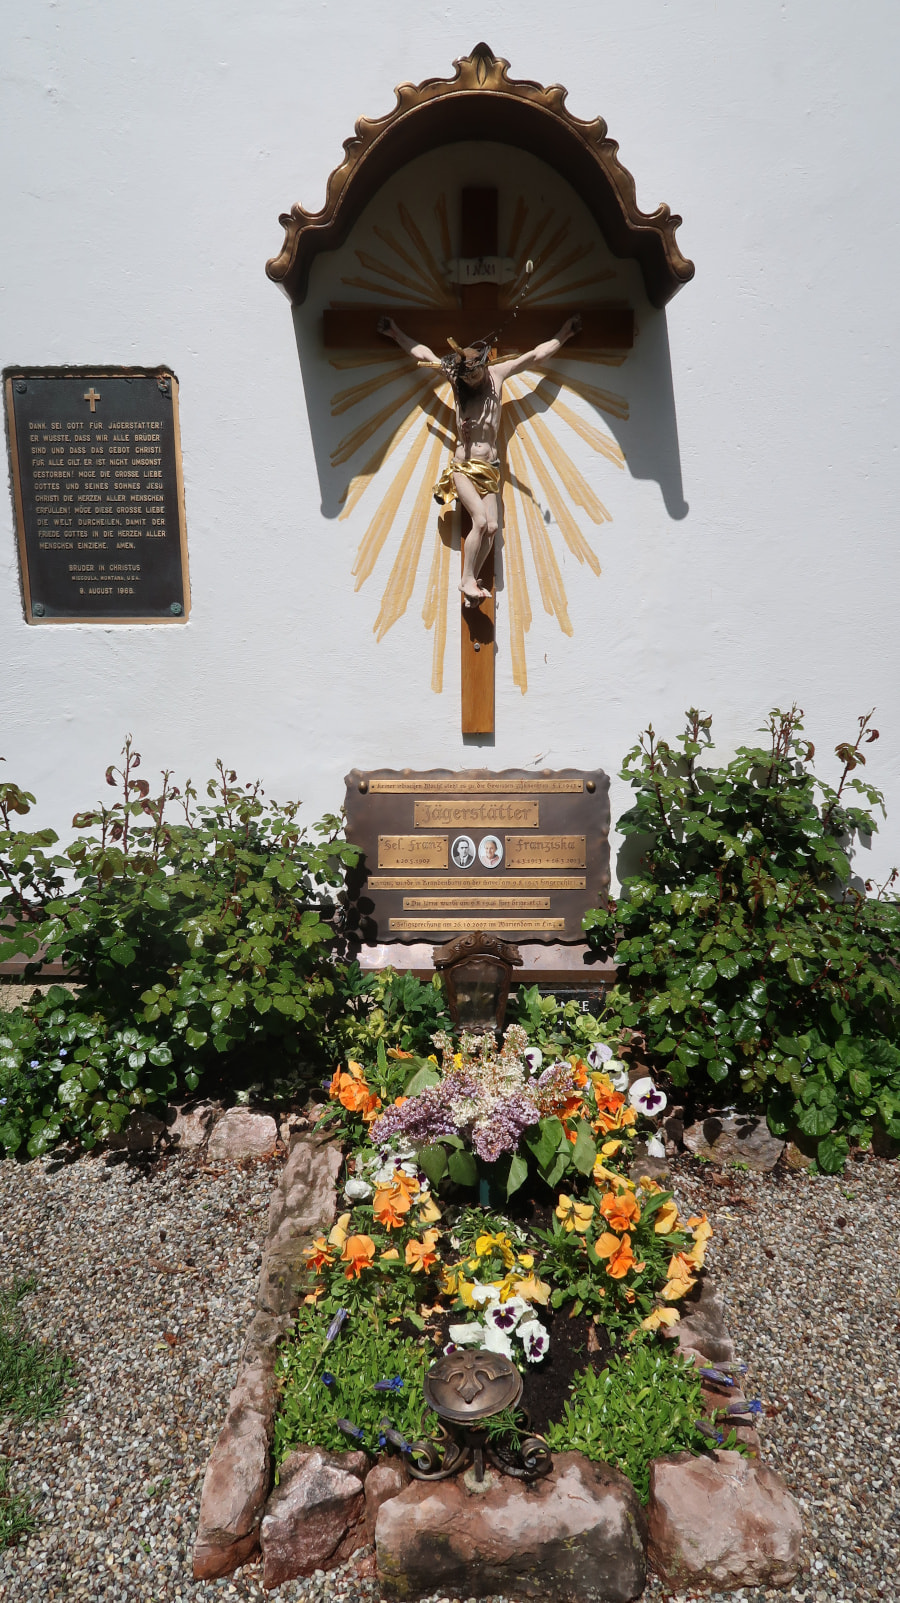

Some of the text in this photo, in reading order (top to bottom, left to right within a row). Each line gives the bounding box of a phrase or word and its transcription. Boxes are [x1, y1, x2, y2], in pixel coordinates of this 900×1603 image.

[422, 804, 532, 825] Jägerstätter
[384, 838, 442, 852] Sel. Franz
[515, 838, 575, 852] Franziska
